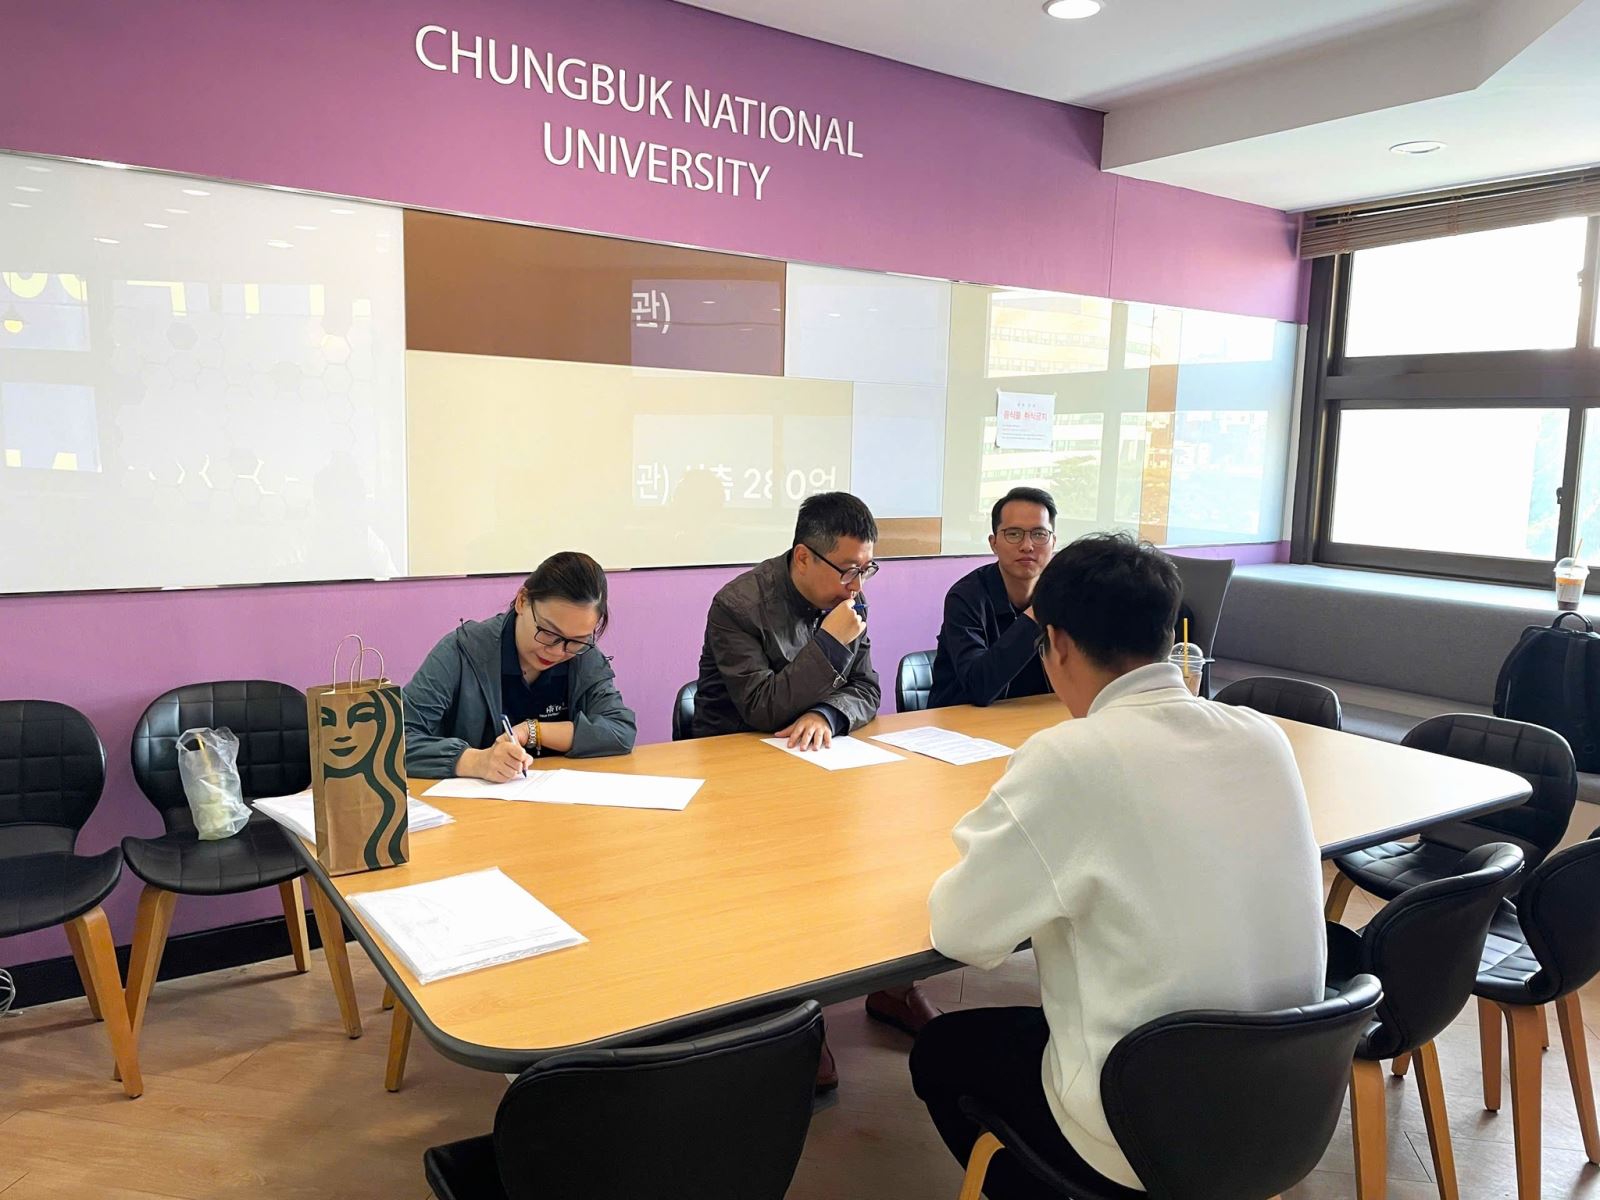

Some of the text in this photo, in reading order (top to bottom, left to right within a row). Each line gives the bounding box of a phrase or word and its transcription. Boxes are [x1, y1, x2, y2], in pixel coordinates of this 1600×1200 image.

[415, 24, 864, 158] CHUNGBUK NATIONAL
[542, 121, 771, 201] UNIVERSITY
[637, 462, 670, 505] 관)
